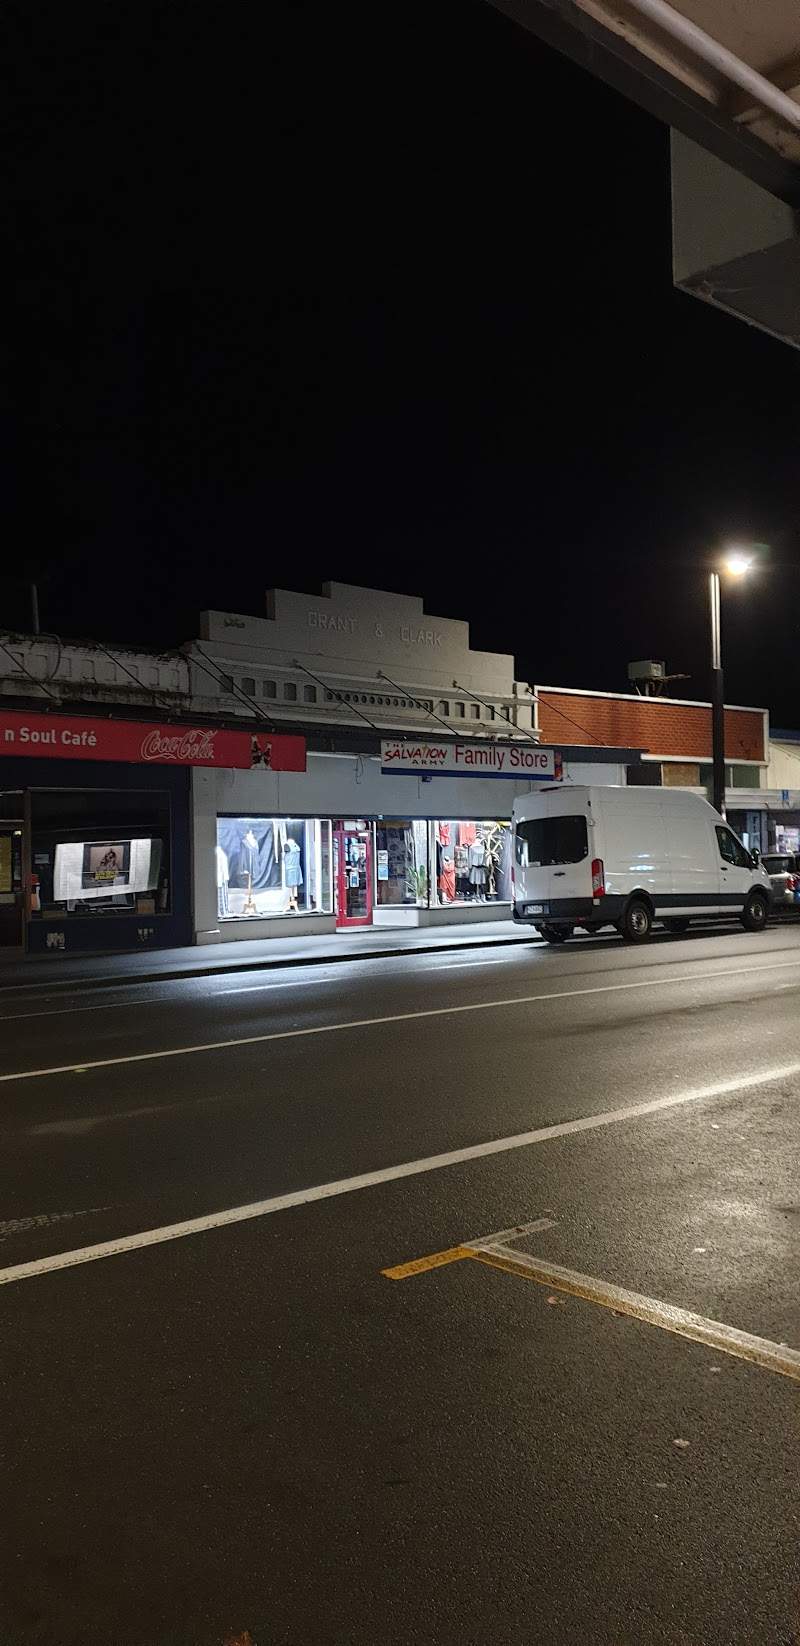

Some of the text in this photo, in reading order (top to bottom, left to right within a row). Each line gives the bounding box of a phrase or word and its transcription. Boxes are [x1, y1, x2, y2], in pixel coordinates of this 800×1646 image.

[309, 611, 444, 647] GRANT & CLARK
[5, 727, 97, 746] n Soul Café
[141, 730, 218, 761] Coca-Cola
[384, 746, 448, 761] SALVATION
[455, 744, 549, 770] Family Store
